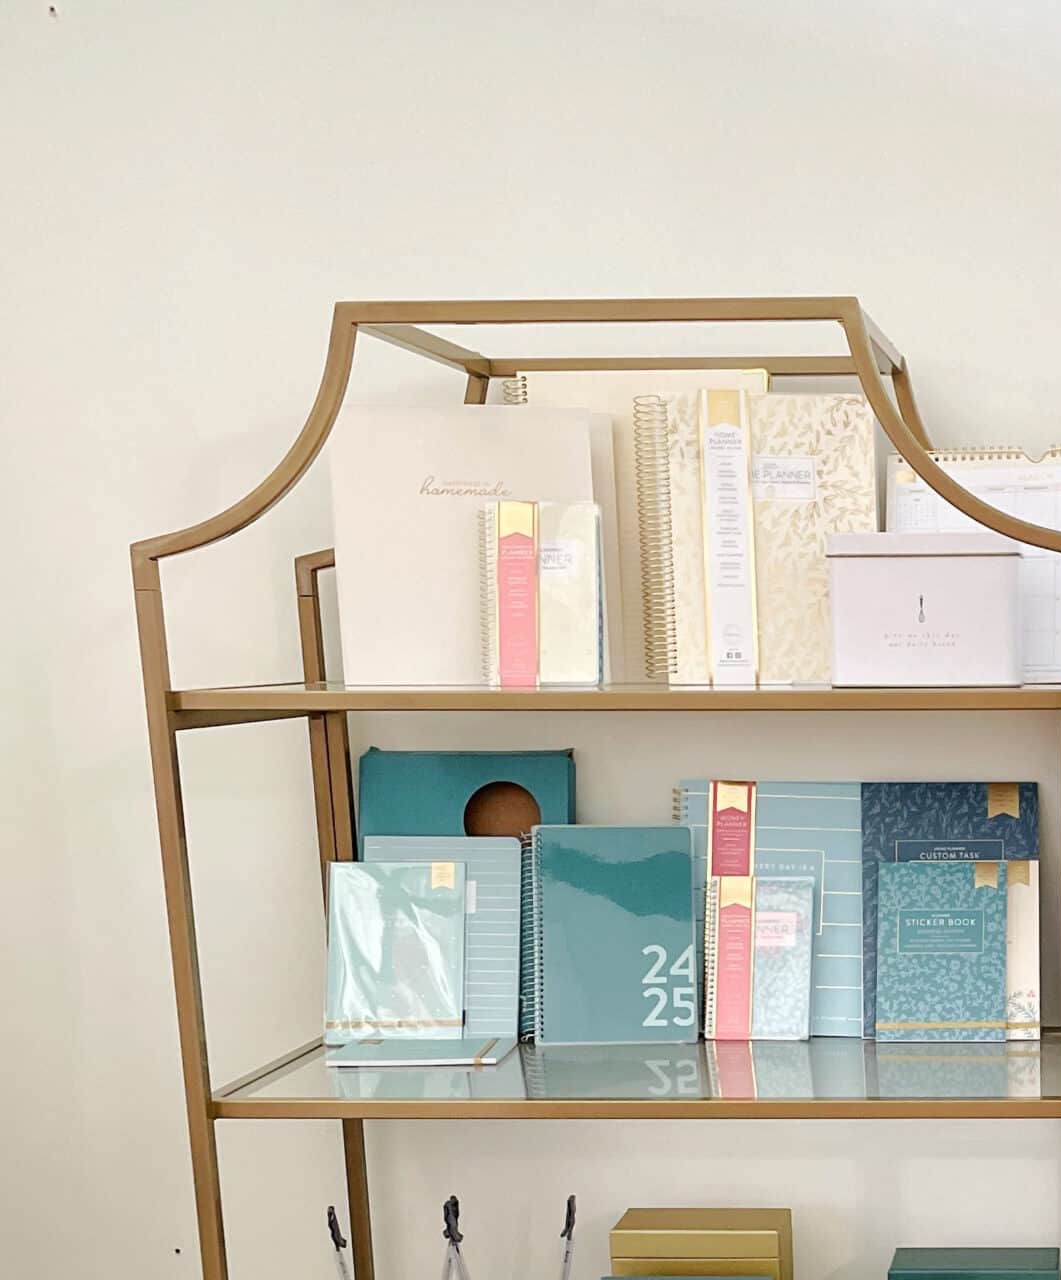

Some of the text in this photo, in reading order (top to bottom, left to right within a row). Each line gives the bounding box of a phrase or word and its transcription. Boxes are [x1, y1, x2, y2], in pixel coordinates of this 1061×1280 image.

[419, 476, 513, 497] homemade
[919, 852, 957, 860] CUSTOM
[905, 918, 977, 927] STICKER BOOK
[641, 944, 695, 985] 24
[642, 986, 696, 1028] 25
